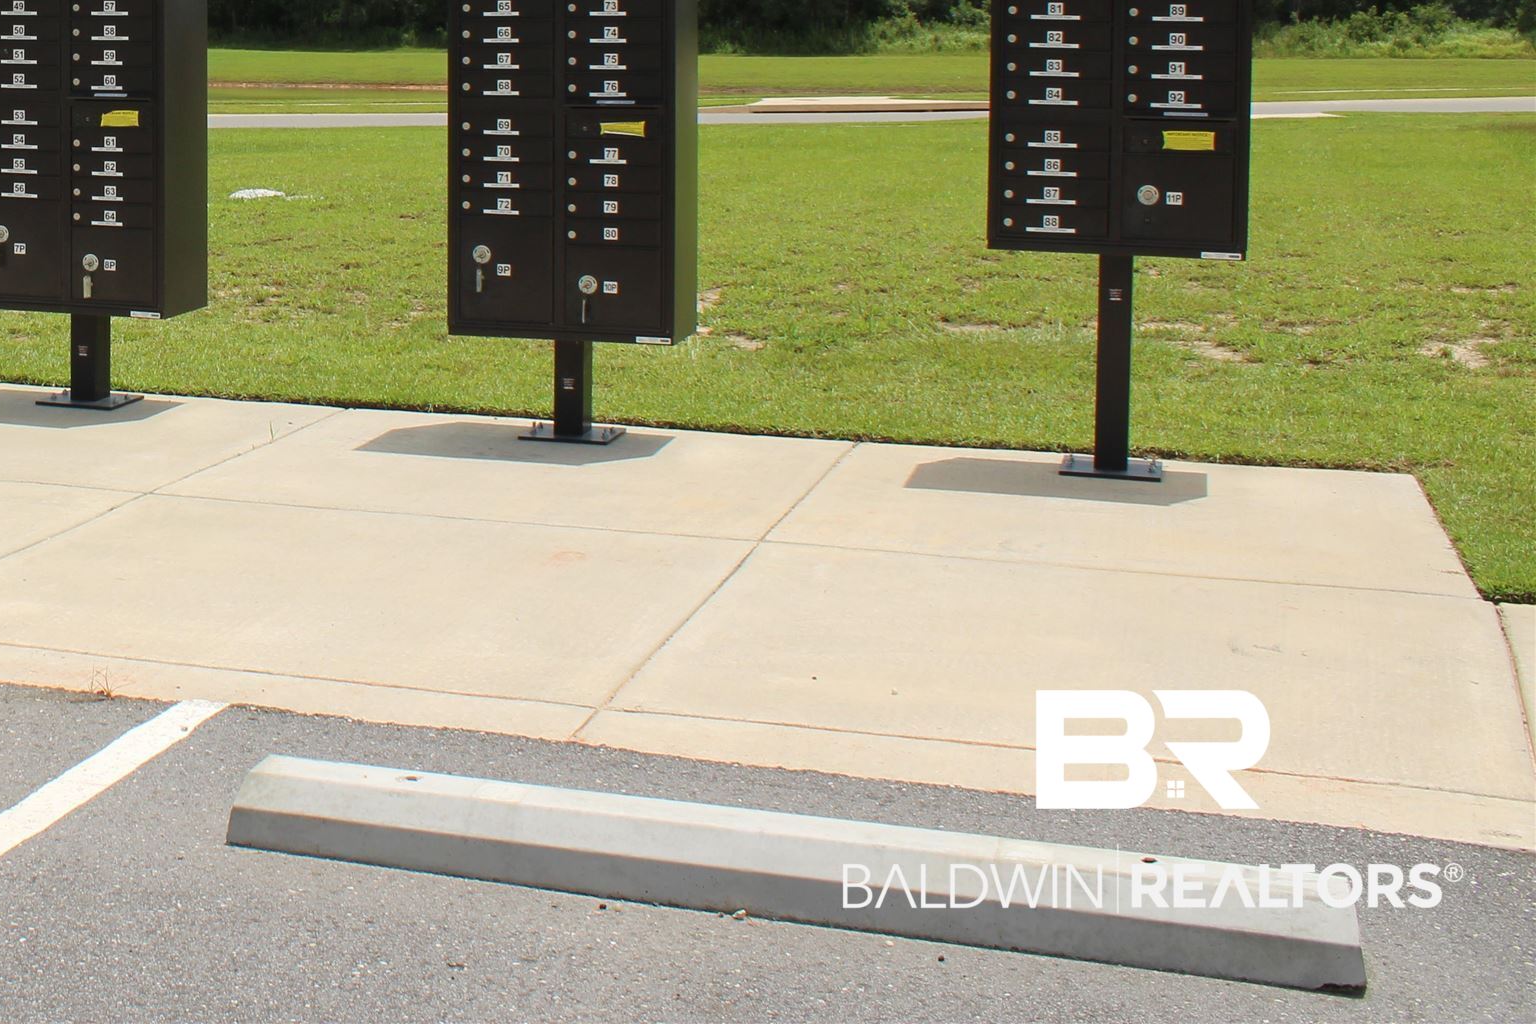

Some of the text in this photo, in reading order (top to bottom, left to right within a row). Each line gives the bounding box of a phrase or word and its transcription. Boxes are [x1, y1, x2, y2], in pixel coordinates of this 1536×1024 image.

[14, 2, 24, 10] 49
[105, 2, 115, 10] 57
[498, 1, 510, 11] 65
[605, 1, 616, 11] 73
[1049, 4, 1062, 14] 81
[1171, 5, 1184, 15] 89
[14, 26, 24, 35] 50
[105, 27, 115, 35] 58
[498, 28, 510, 37] 66
[605, 28, 616, 38] 74
[1048, 32, 1061, 42] 82
[1171, 34, 1184, 44] 90
[14, 50, 24, 59] 51
[105, 51, 115, 60] 59
[498, 54, 510, 64] 67
[605, 54, 616, 64] 75
[1048, 61, 1061, 71] 83
[1170, 63, 1183, 73] 91
[14, 74, 24, 83] 52
[105, 76, 115, 85] 60
[498, 81, 510, 90] 68
[605, 82, 616, 91] 76
[1047, 89, 1060, 99] 84
[1170, 92, 1183, 102] 92
[14, 111, 24, 120] 53
[498, 120, 510, 130] 69
[14, 135, 24, 144] 54
[105, 138, 115, 146] 61
[1046, 132, 1059, 142] 85
[498, 146, 510, 156] 70
[605, 149, 616, 158] 77
[14, 159, 24, 168] 55
[105, 162, 115, 171] 62
[1046, 160, 1059, 170] 86
[498, 173, 510, 183] 71
[605, 176, 616, 186] 78
[14, 184, 24, 192] 56
[105, 187, 115, 196] 63
[1045, 188, 1058, 198] 87
[498, 199, 510, 209] 72
[1167, 194, 1181, 204] 11P
[605, 203, 616, 212] 79
[105, 211, 115, 220] 64
[1044, 216, 1057, 226] 88
[605, 229, 616, 239] 80
[15, 244, 25, 253] 7P
[105, 261, 115, 269] 8P
[498, 265, 509, 275] 9P
[604, 283, 616, 292] 10P
